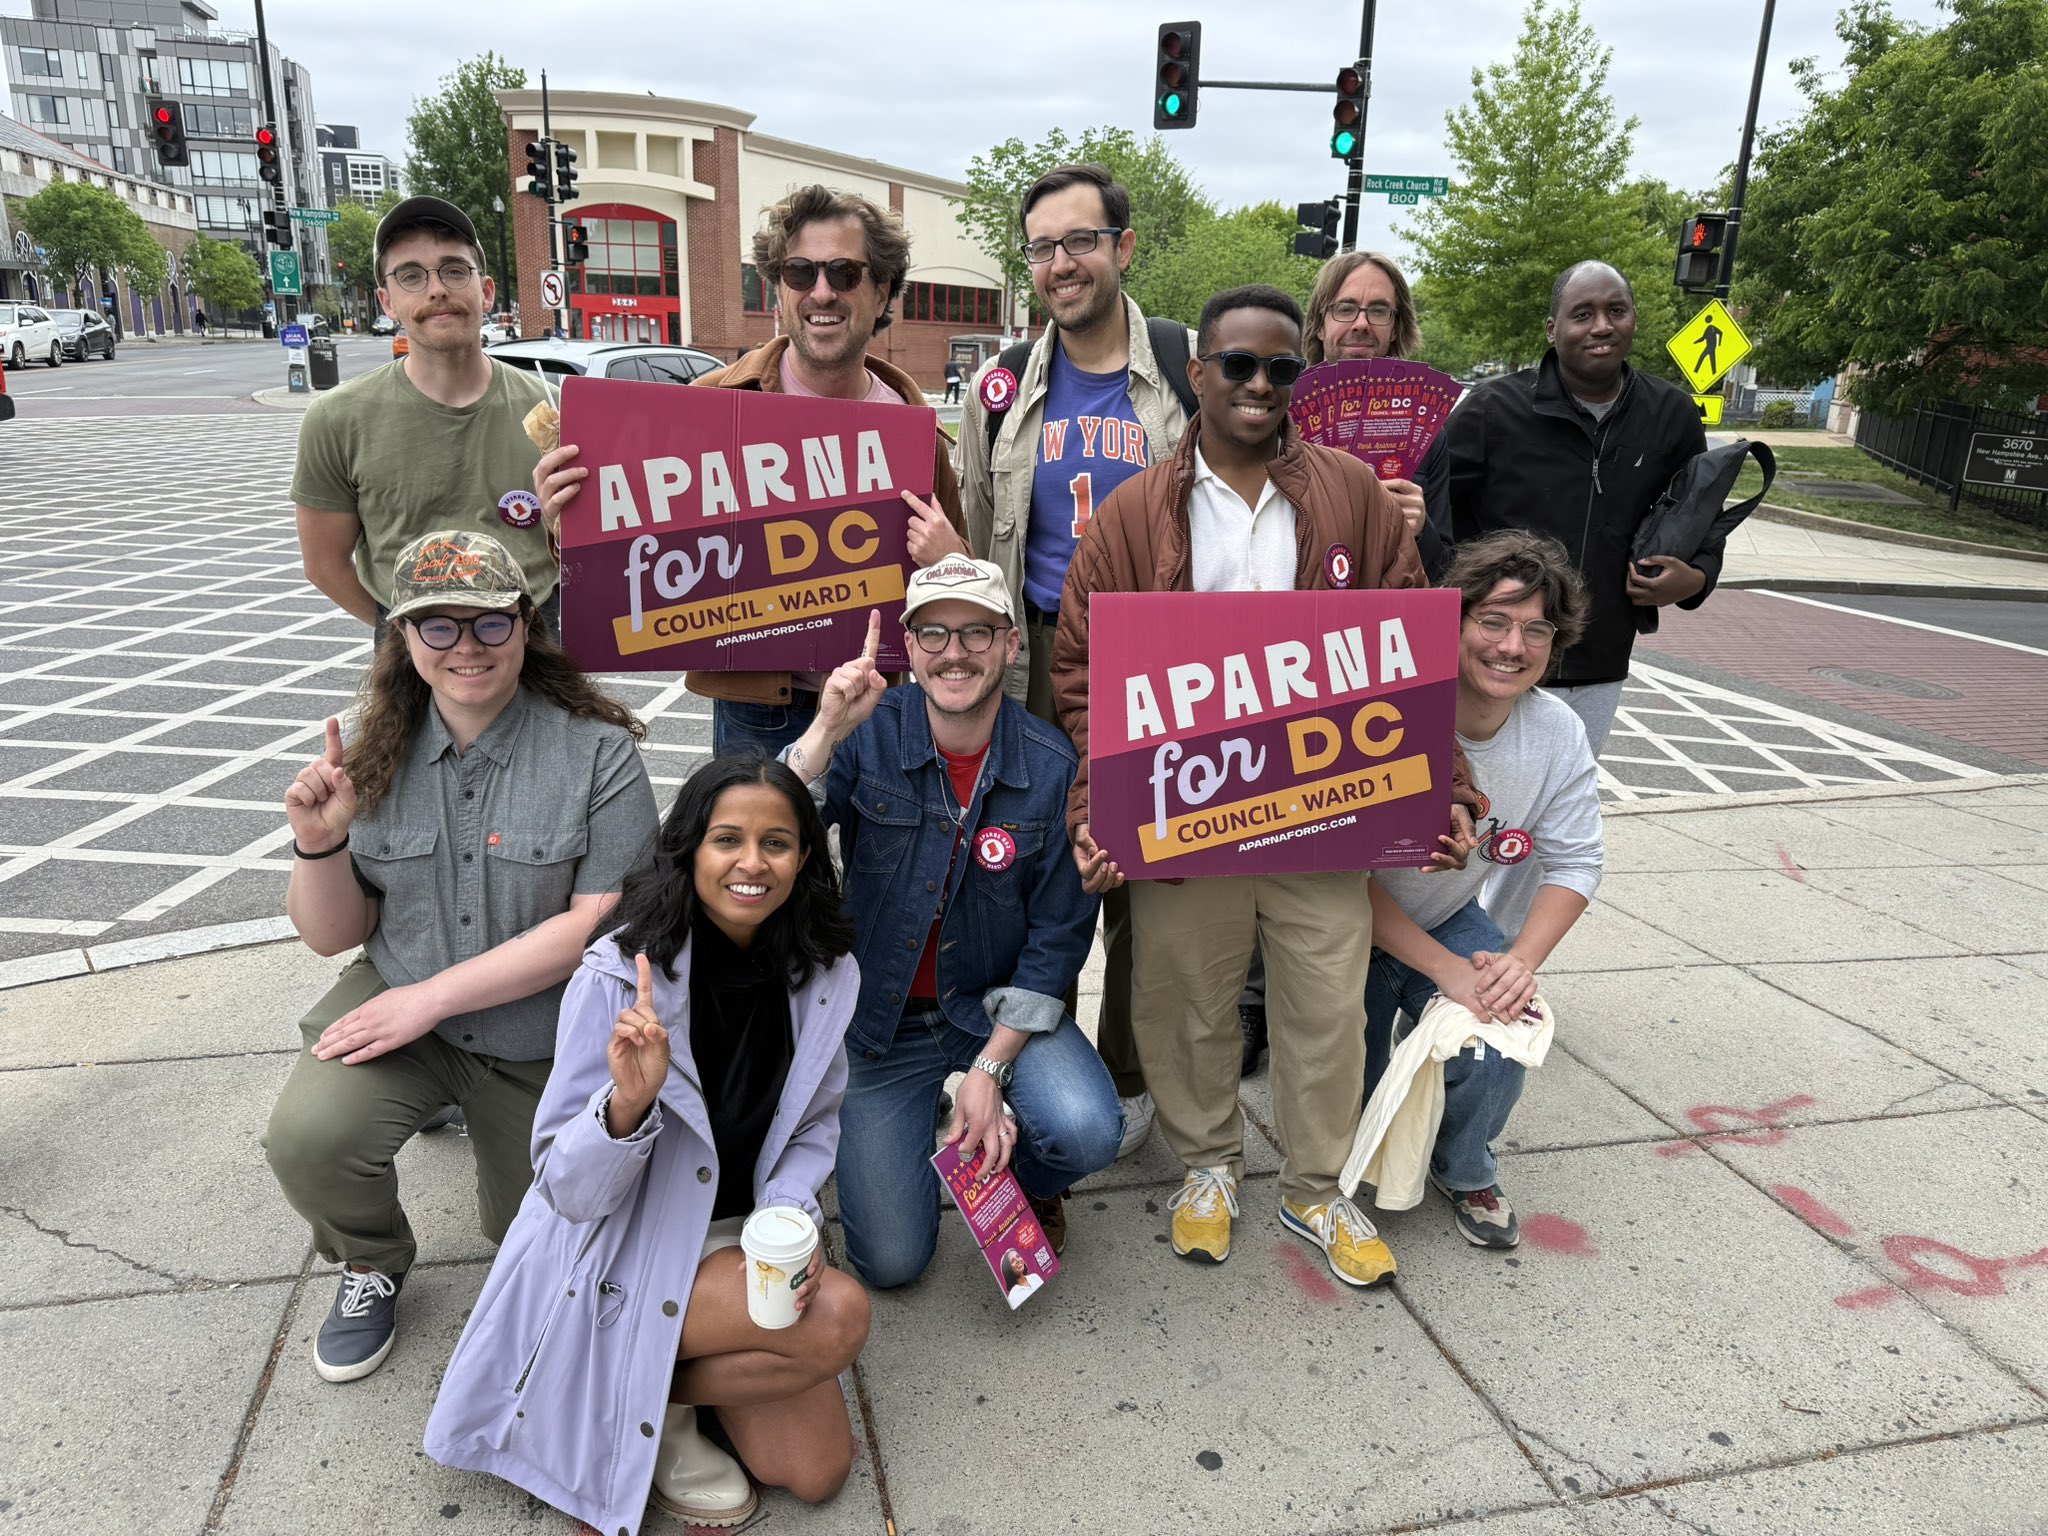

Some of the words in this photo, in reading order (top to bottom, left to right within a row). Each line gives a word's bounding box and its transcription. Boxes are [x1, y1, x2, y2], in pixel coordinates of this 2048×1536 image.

[1366, 178, 1383, 189] Rock
[1385, 180, 1404, 189] Creek
[1406, 180, 1429, 190] Church
[1391, 194, 1416, 203] 800
[302, 209, 331, 219] Hampshire
[612, 298, 637, 306] 3642
[1368, 384, 1420, 397] APARNA
[1367, 398, 1390, 414] for
[1391, 398, 1411, 408] DC
[1043, 419, 1069, 463] W
[2002, 438, 2033, 450] 3670
[1992, 449, 2025, 458] Hampshire
[600, 430, 894, 532] APARNA
[2005, 470, 2016, 479] M
[415, 552, 448, 572] Local
[624, 534, 743, 633] for
[764, 510, 880, 575] DC
[926, 566, 978, 580] OKLAHOMA
[654, 601, 763, 637] COUNCIL
[779, 583, 851, 612] WARD
[858, 579, 869, 597] 1
[715, 618, 832, 648] APARNAFORDC.COM
[1126, 618, 1417, 741] APARNA
[1149, 738, 1266, 840] for
[1286, 702, 1404, 774] DC
[1177, 802, 1286, 843] COUNCIL
[1302, 778, 1375, 811] WARD
[1382, 773, 1393, 792] 1
[1238, 815, 1357, 852] APARNAFORDC.COM
[964, 1182, 981, 1211] for
